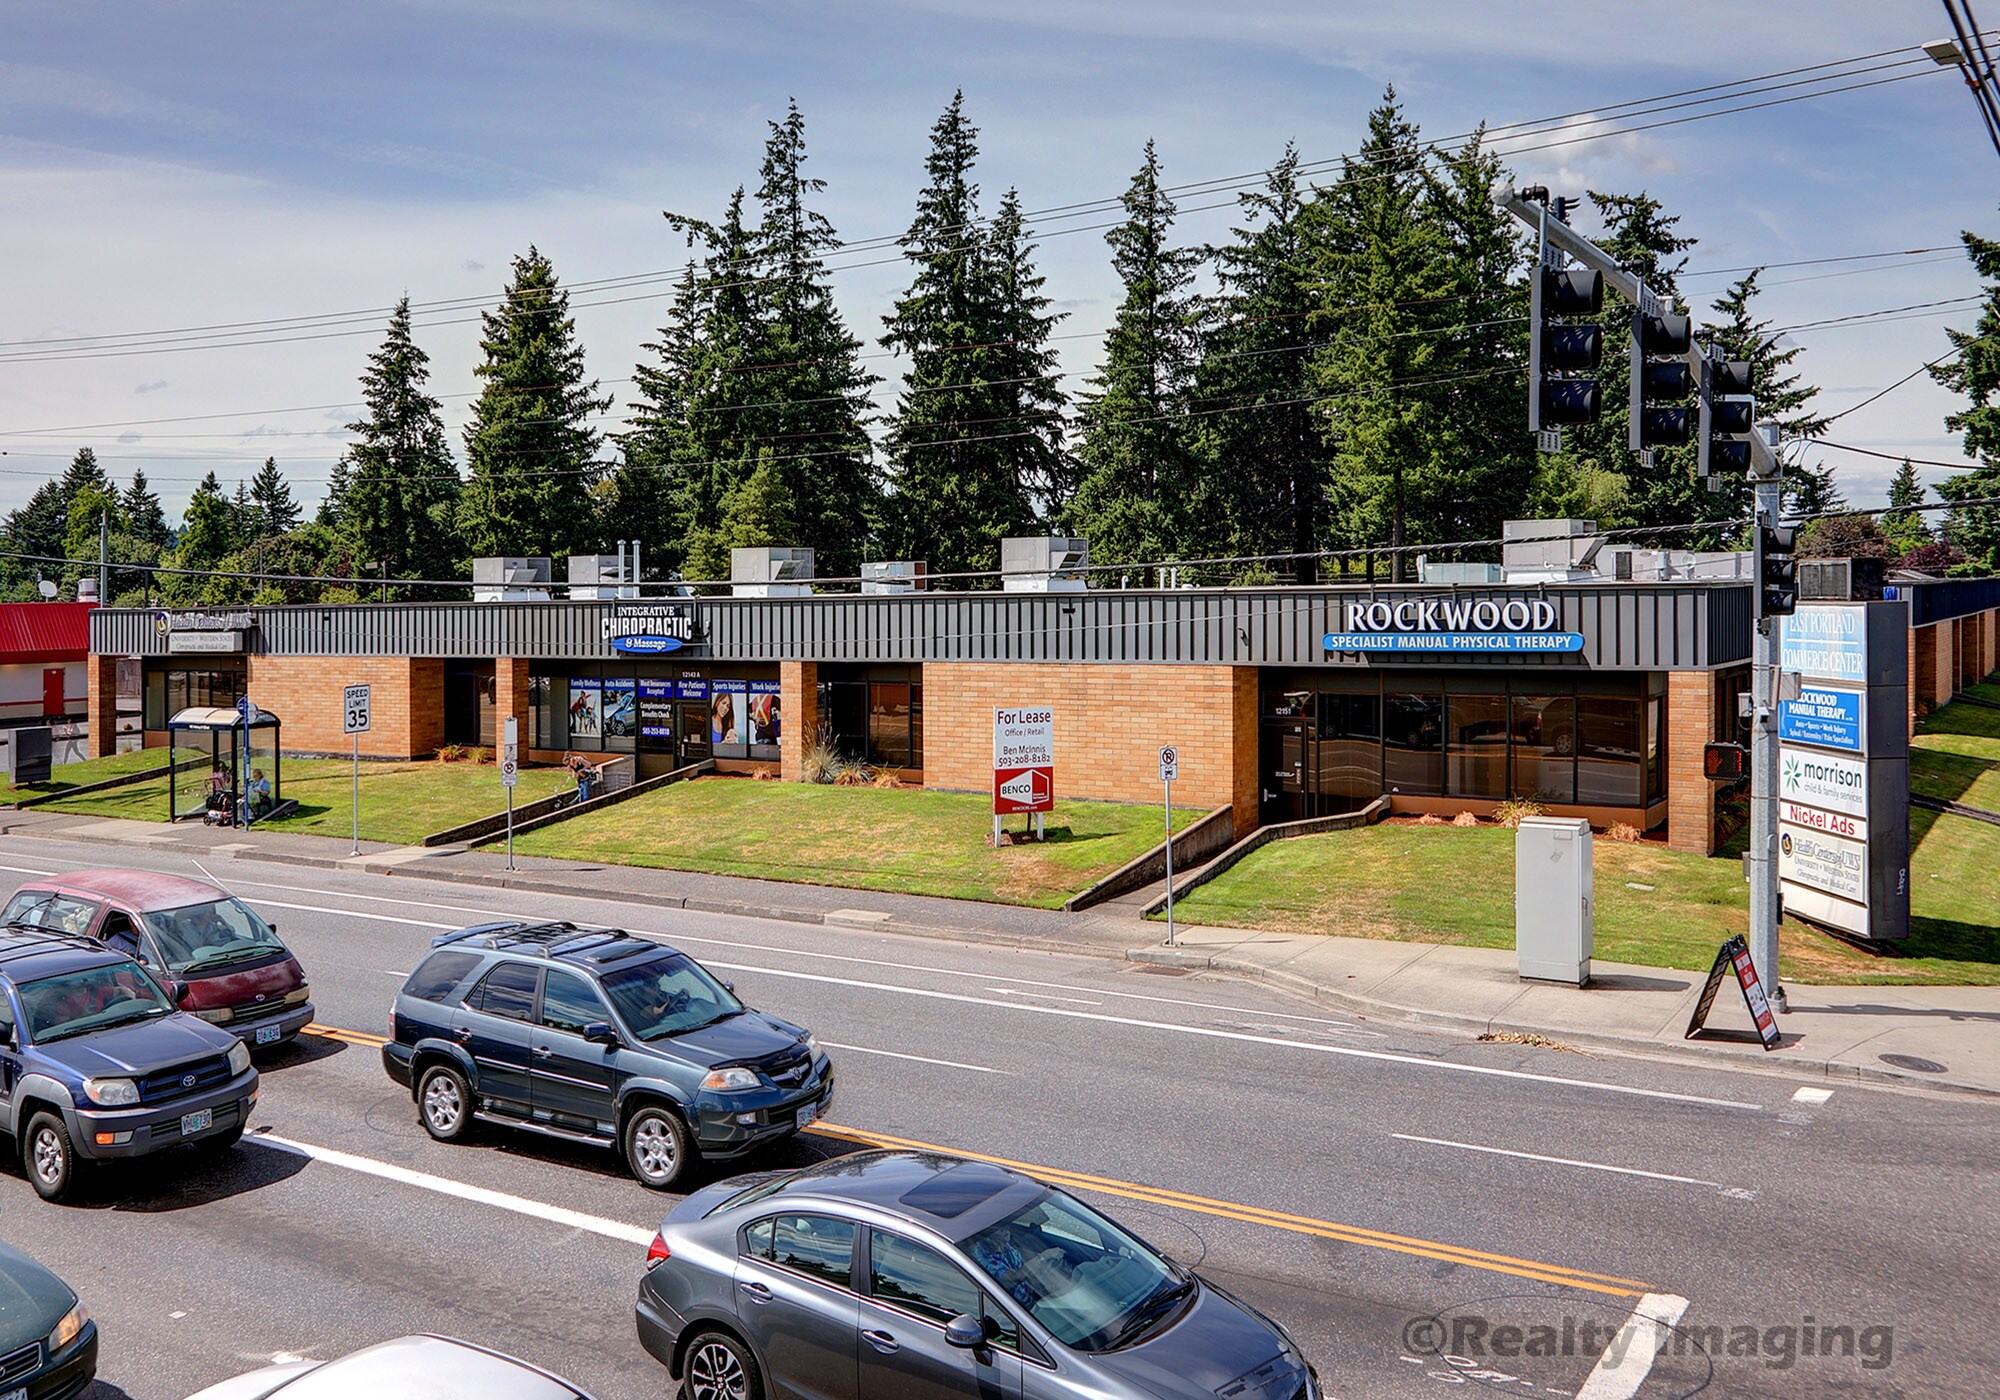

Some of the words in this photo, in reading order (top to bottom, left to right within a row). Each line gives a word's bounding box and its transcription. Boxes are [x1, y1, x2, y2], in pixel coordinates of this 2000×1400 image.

[618, 607, 674, 616] INTEGRATIVE
[1348, 600, 1556, 631] ROCKWOOD
[602, 617, 692, 640] CHIROPRACTIC
[1790, 612, 1808, 632] EAST
[1811, 613, 1854, 634] PORTLAND
[625, 638, 633, 648] &
[633, 638, 666, 651] Massage
[1332, 635, 1393, 648] SPECIALIST
[1398, 635, 1449, 648] MANUAL
[1453, 635, 1510, 648] PHYSICAL
[1514, 635, 1571, 649] THERAPY
[1783, 649, 1828, 671] COMMERCE
[1830, 652, 1863, 673] CENTER
[688, 681, 706, 689] Patients
[713, 682, 728, 691] Sports
[728, 682, 746, 691] Injuries
[765, 683, 780, 692] Injurie
[347, 689, 368, 699] SPEED
[1797, 692, 1837, 706] OCKWOOD
[349, 699, 366, 708] LIMIT
[348, 709, 367, 728] 35
[997, 711, 1016, 725] For
[1019, 710, 1051, 724] Lease
[1789, 703, 1815, 716] MANUAL
[1817, 705, 1846, 720] THERAPY
[1004, 729, 1023, 737] Office
[1027, 728, 1045, 736] Retail
[1003, 746, 1017, 755] Ben
[1018, 744, 1046, 754] McInnis
[1804, 763, 1862, 788] morrison
[1002, 784, 1031, 795] BENCO
[1804, 782, 1816, 793] child
[1817, 784, 1822, 794] &
[1823, 785, 1839, 800] family
[1840, 791, 1863, 803] services
[1790, 805, 1826, 828] Nickel
[1830, 816, 1855, 835] Ads
